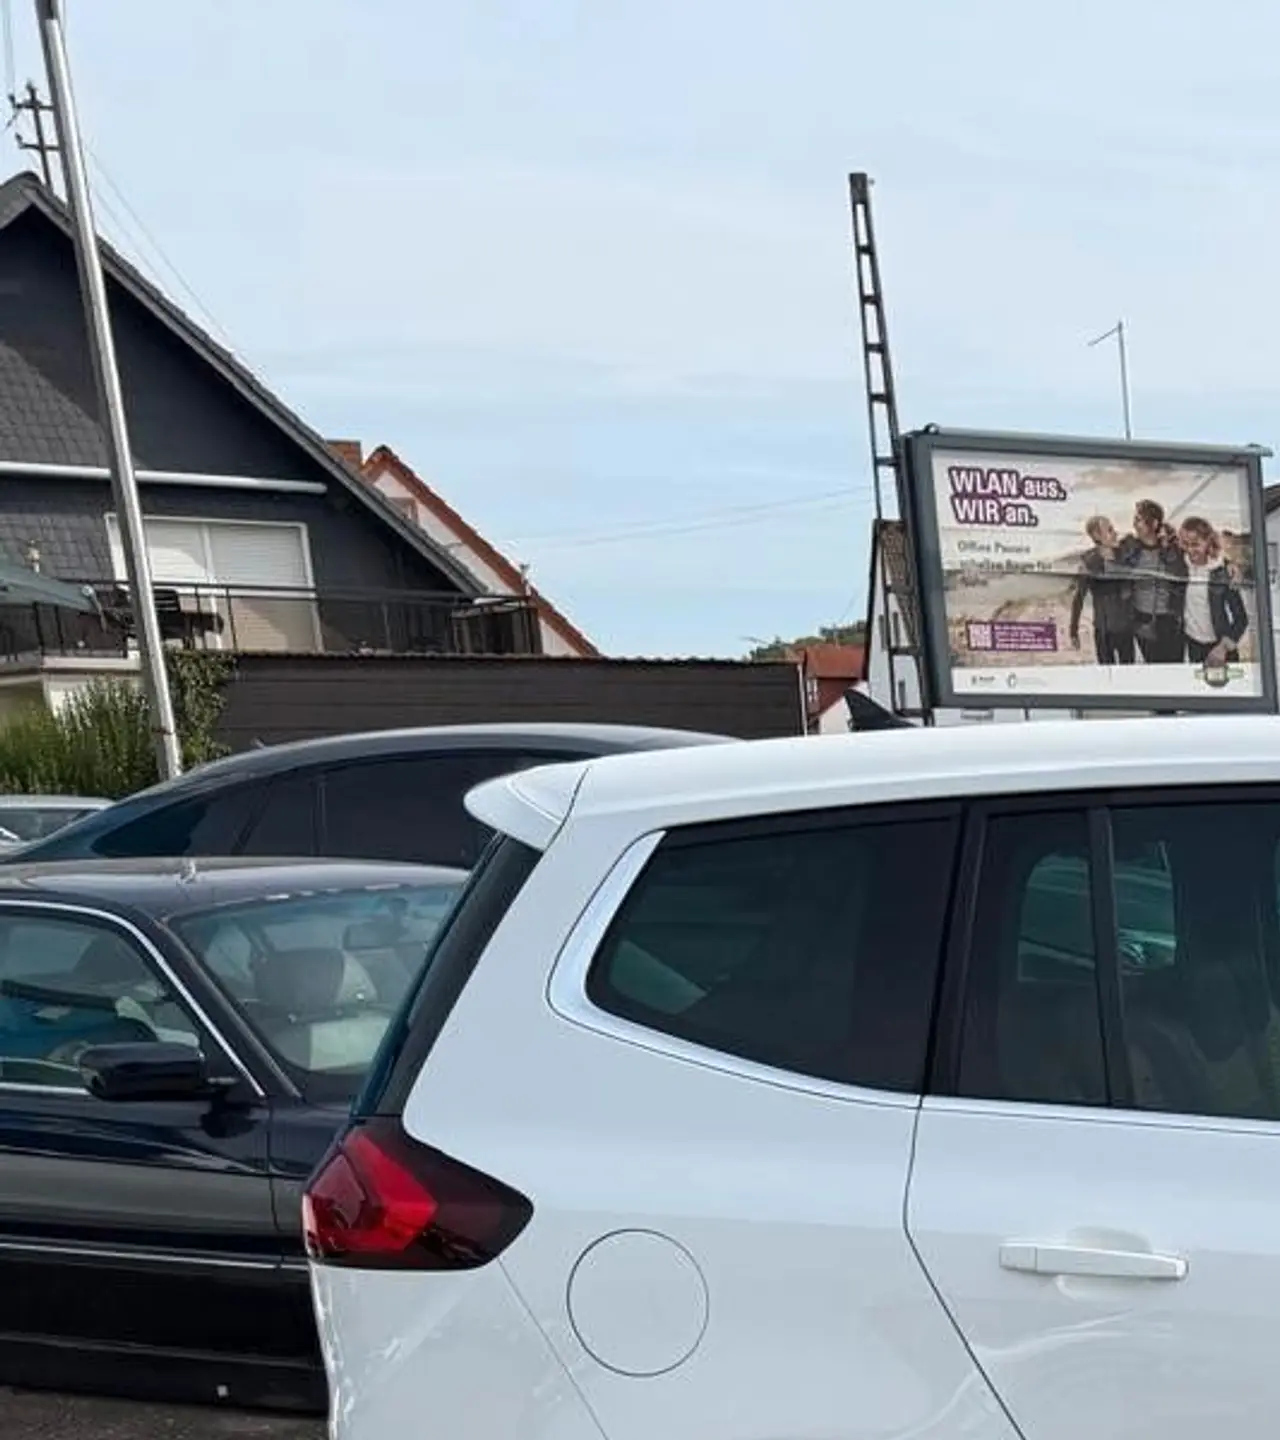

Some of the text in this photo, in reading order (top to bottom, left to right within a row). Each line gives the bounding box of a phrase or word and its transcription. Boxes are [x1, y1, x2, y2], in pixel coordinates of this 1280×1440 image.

[949, 468, 1065, 499] WLAN aus.
[953, 497, 1037, 525] WIR an.
